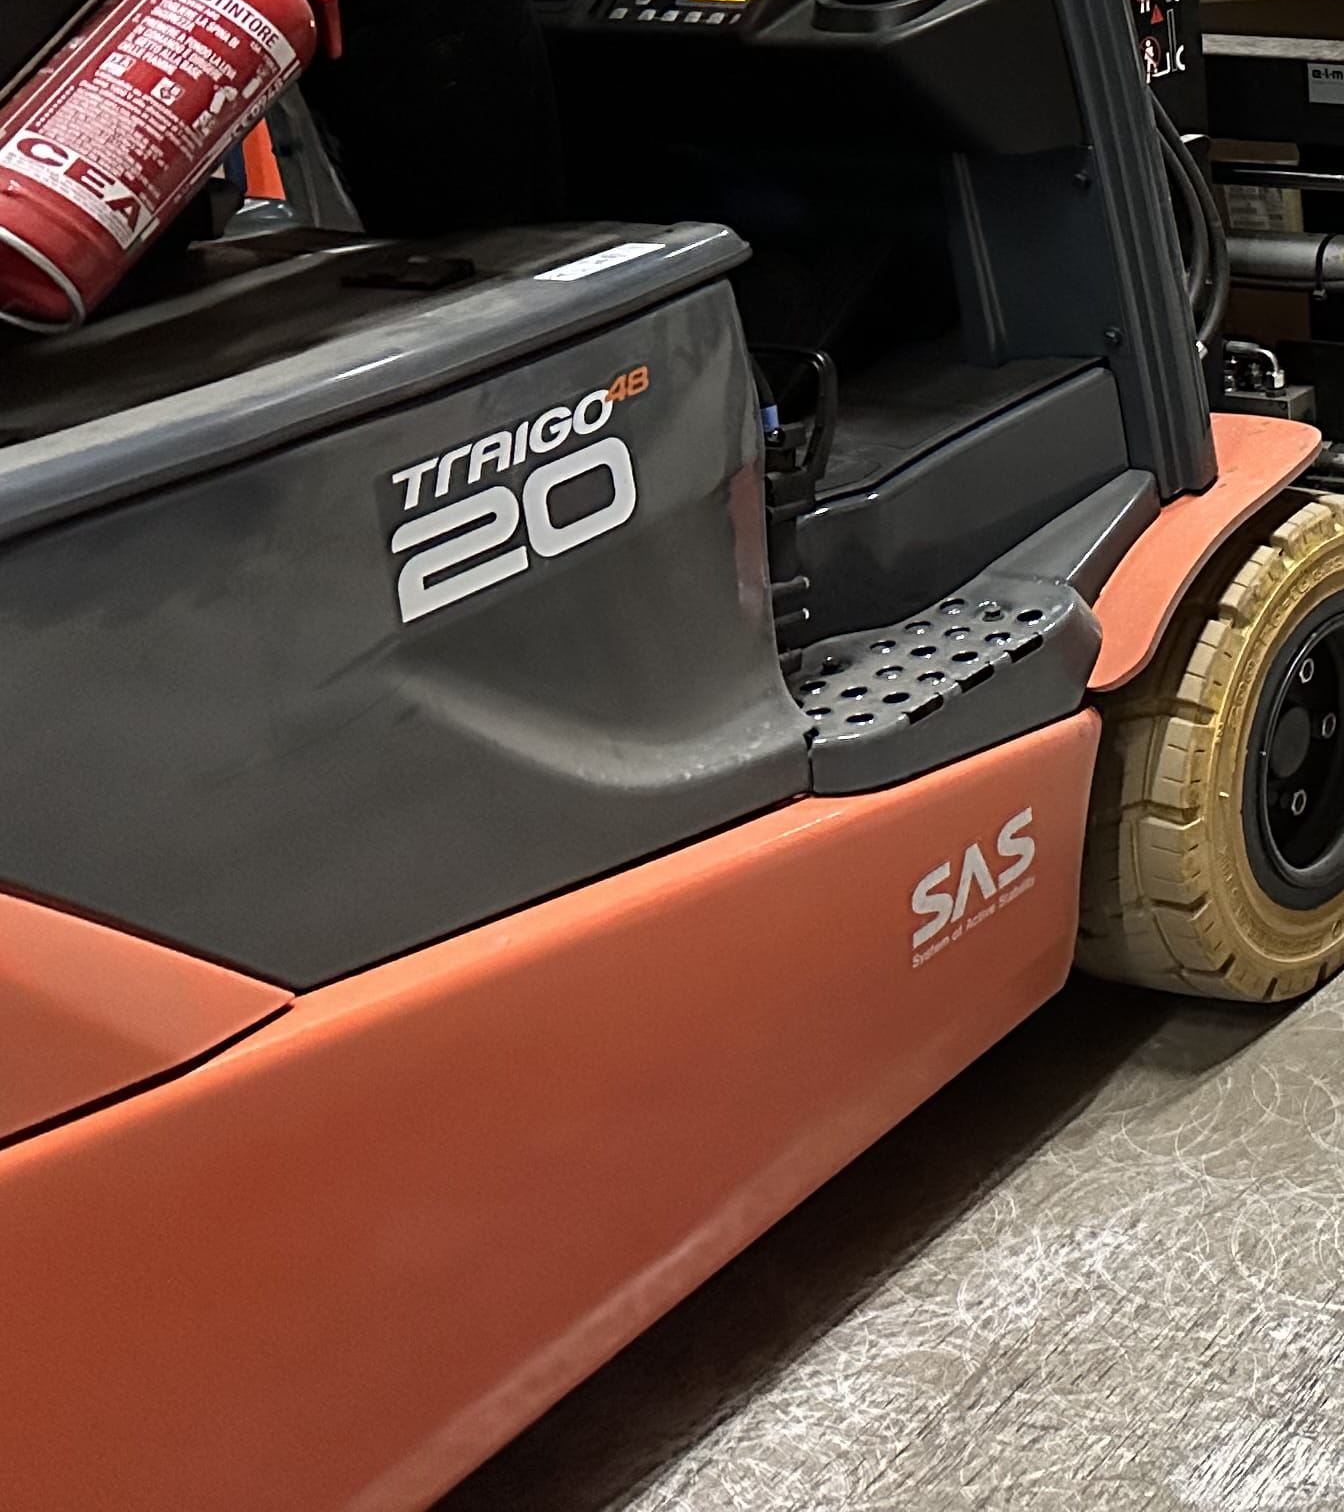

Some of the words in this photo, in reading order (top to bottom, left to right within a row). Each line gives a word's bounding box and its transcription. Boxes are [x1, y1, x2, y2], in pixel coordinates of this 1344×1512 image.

[16, 138, 141, 232] CEA
[391, 389, 614, 512] TRAIGO
[391, 437, 638, 624] 20
[911, 805, 1036, 950] SAS
[912, 936, 950, 969] System
